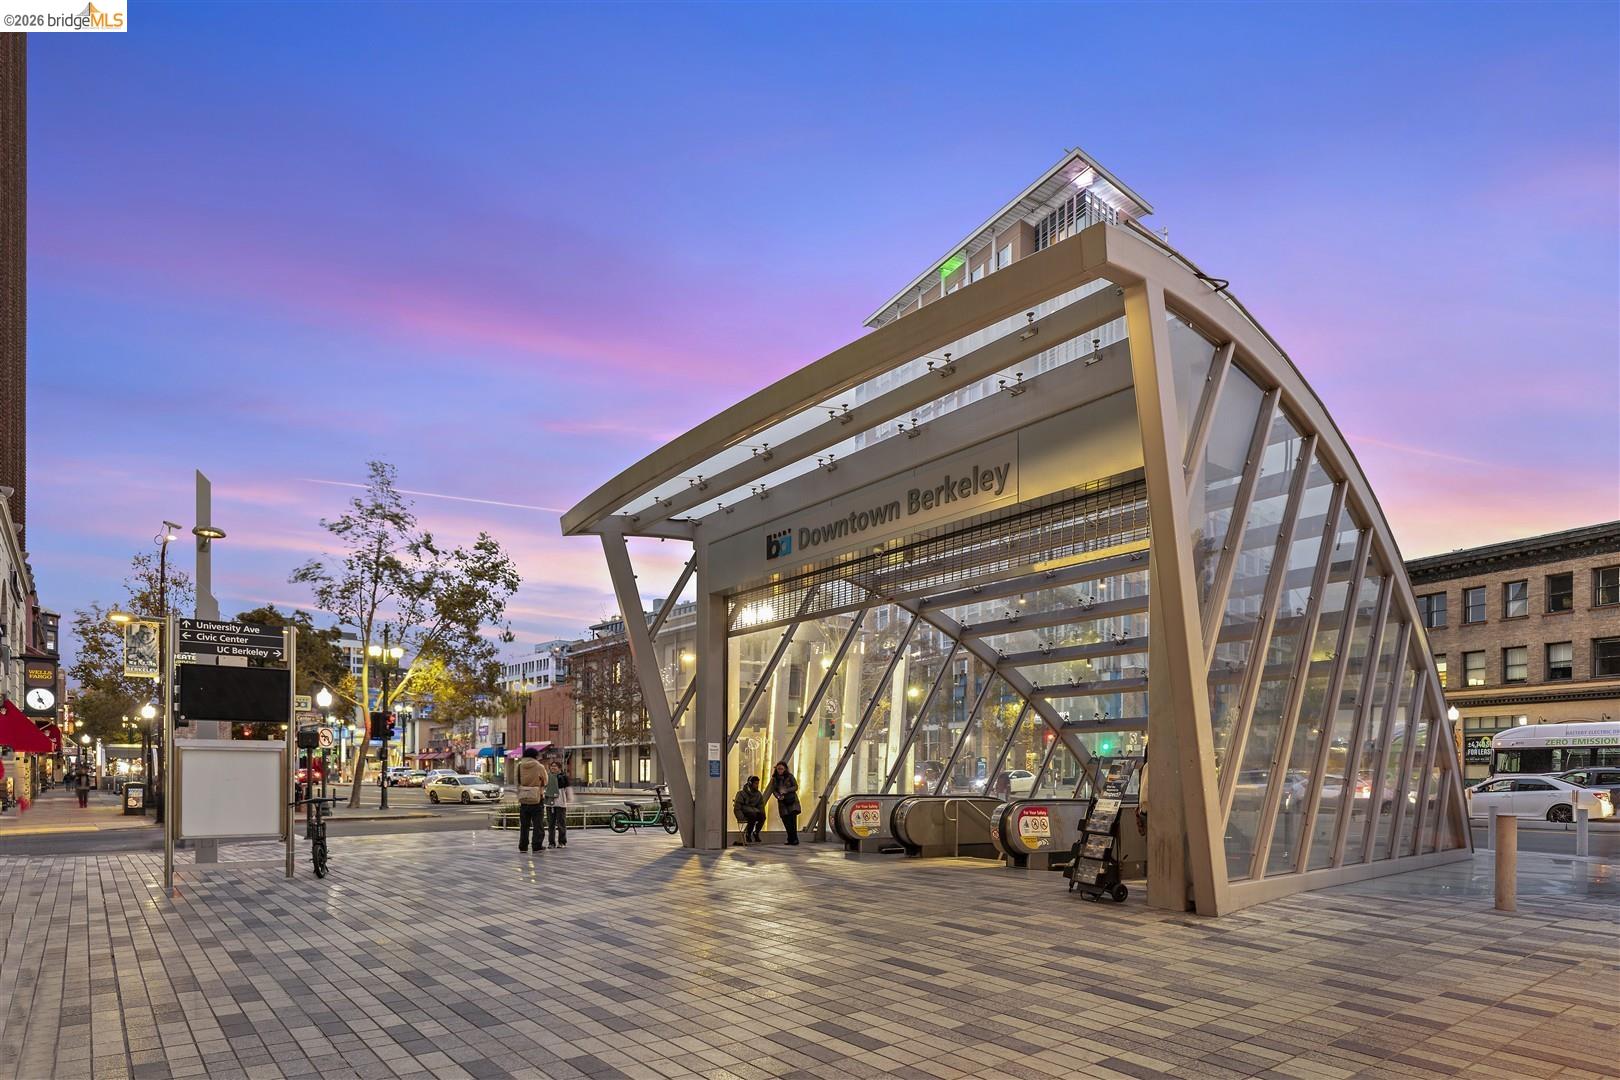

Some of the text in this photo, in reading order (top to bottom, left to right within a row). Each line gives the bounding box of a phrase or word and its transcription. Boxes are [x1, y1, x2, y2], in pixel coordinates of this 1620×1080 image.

[798, 500, 900, 550] Downtown
[907, 462, 1010, 516] Berkeley
[196, 621, 261, 634] University Ave
[196, 633, 249, 644] Civic Center
[216, 645, 269, 658] UC Berkeley
[1545, 737, 1618, 746] ZERO EMISSION
